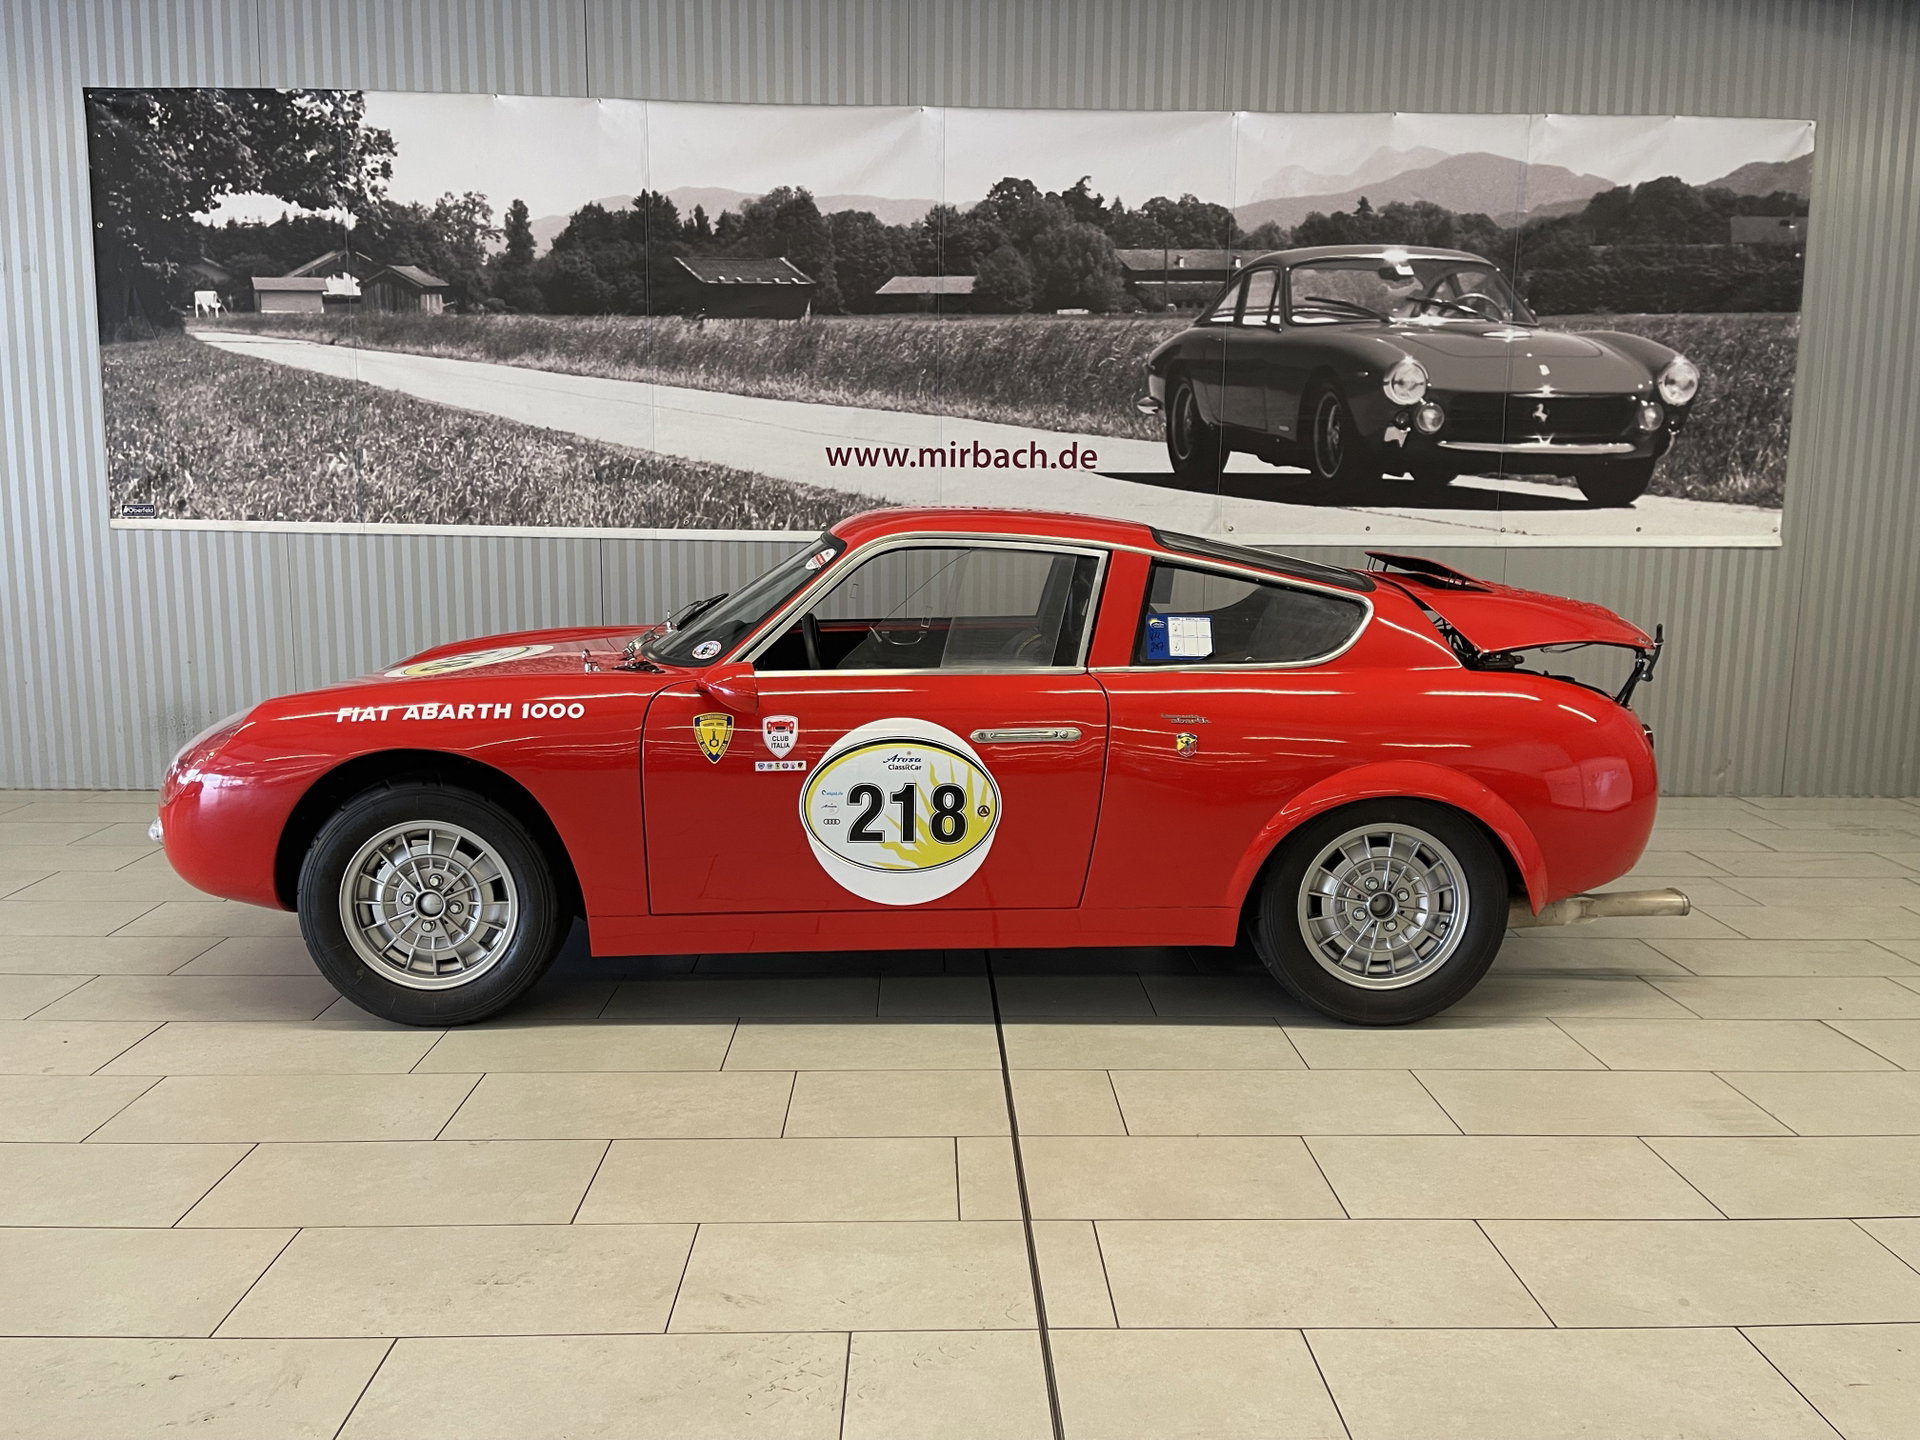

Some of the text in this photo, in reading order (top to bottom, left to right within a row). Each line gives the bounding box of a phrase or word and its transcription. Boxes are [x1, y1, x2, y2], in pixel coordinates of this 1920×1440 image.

[825, 440, 1098, 469] www.mirbach.de
[336, 702, 585, 722] FIAT ABARTH 1000
[882, 753, 922, 763] Arosa
[847, 782, 968, 844] 218
